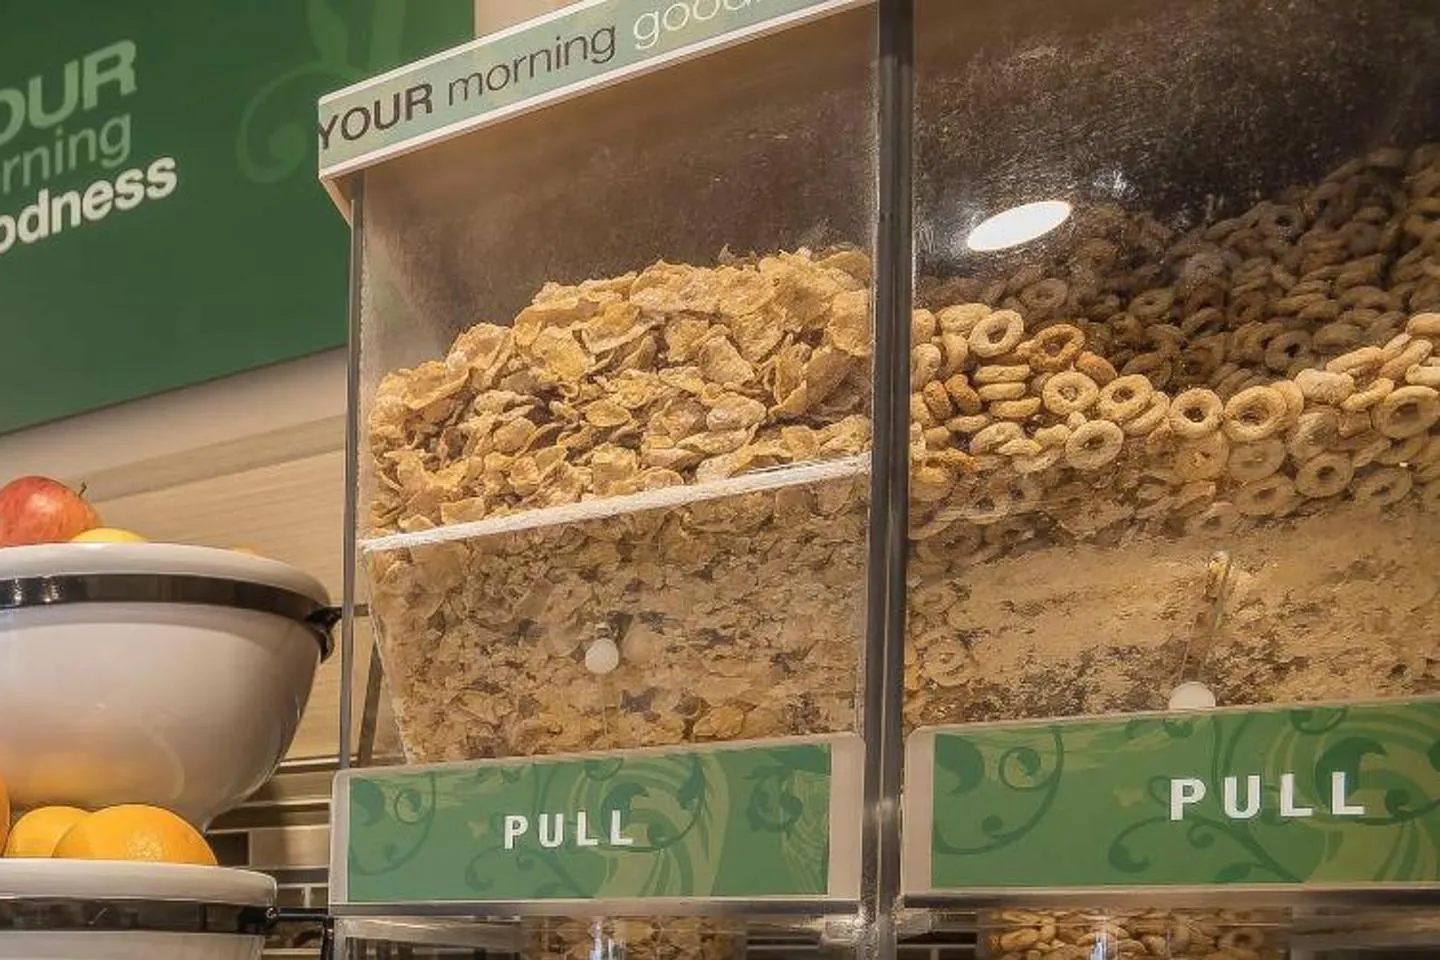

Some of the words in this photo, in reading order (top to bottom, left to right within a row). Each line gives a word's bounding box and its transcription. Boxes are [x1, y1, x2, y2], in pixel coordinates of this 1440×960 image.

[317, 83, 433, 150] YOUR
[449, 25, 616, 106] morning
[633, 0, 752, 49] goo
[1170, 771, 1364, 820] PULL
[504, 809, 633, 849] PULL
